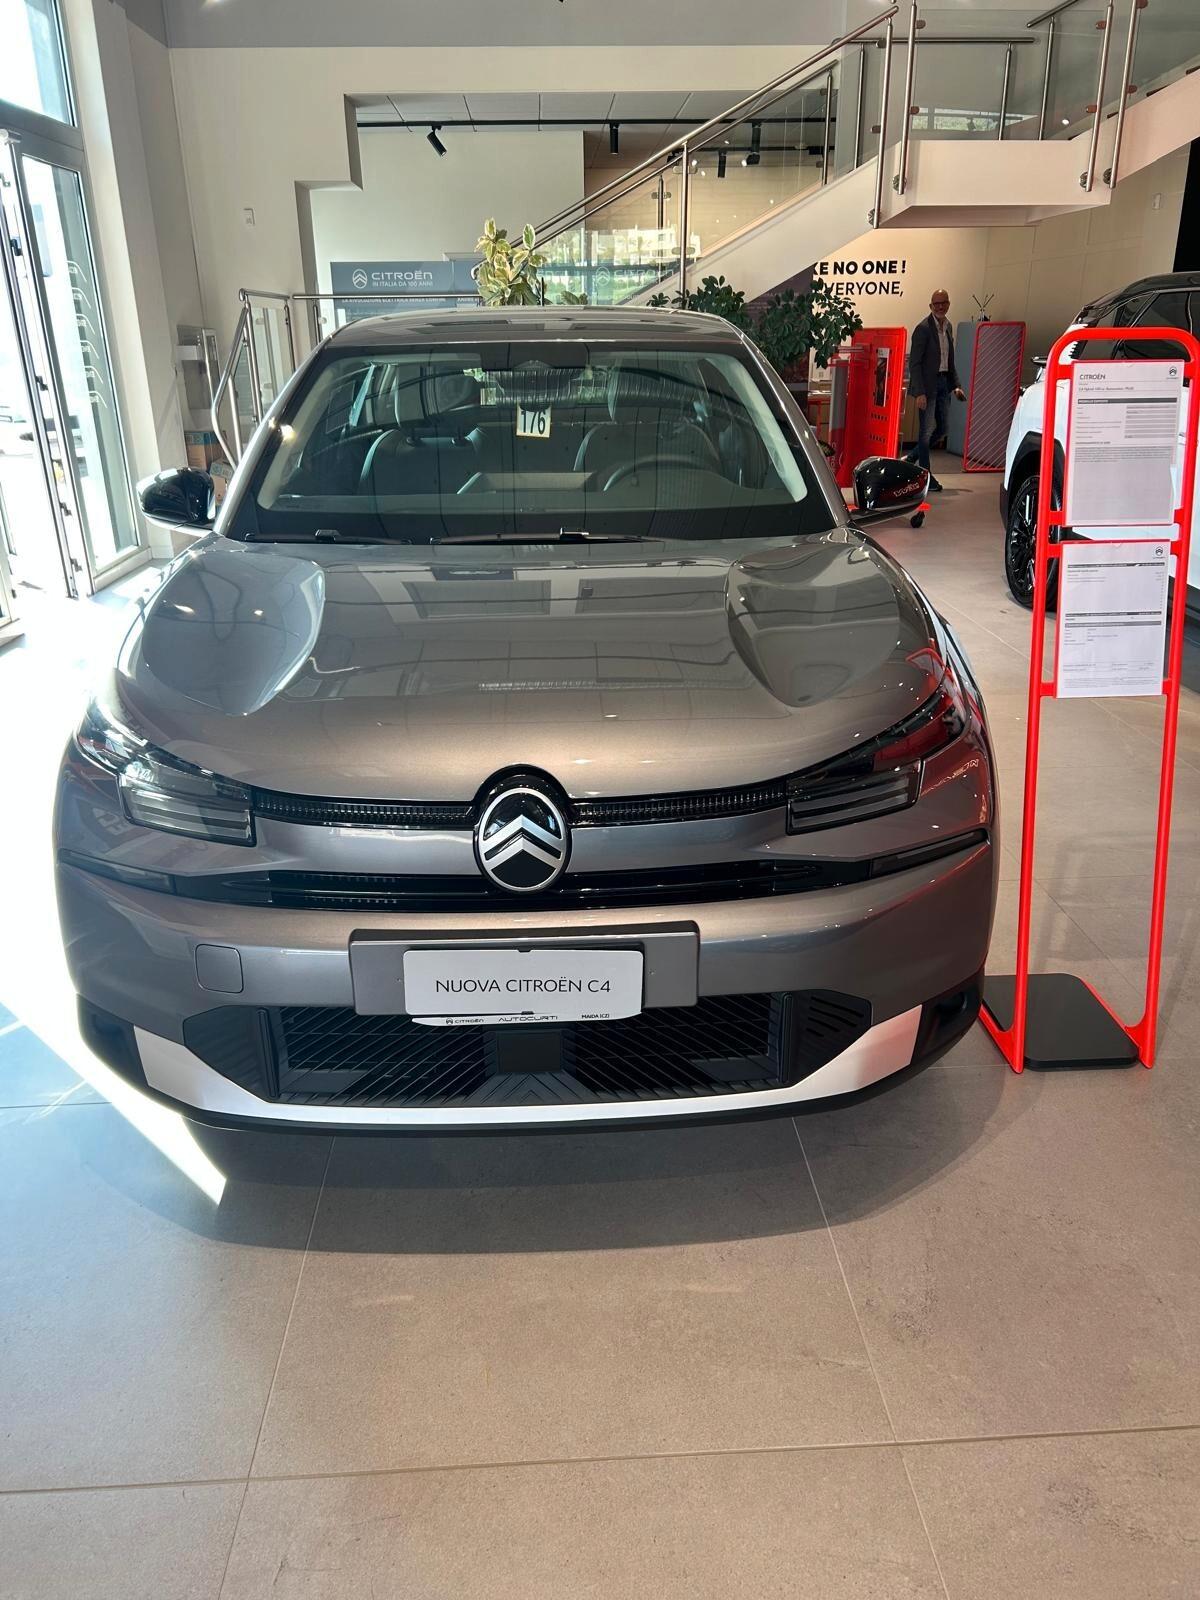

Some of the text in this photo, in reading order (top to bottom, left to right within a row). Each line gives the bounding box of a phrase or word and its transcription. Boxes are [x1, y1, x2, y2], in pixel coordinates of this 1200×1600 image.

[833, 260, 858, 275] NO
[862, 260, 898, 275] ONE
[419, 280, 433, 288] ANNI
[823, 281, 904, 297] VERYONE,
[520, 407, 546, 435] 176
[436, 976, 611, 993] NUOVA CITROËN C4
